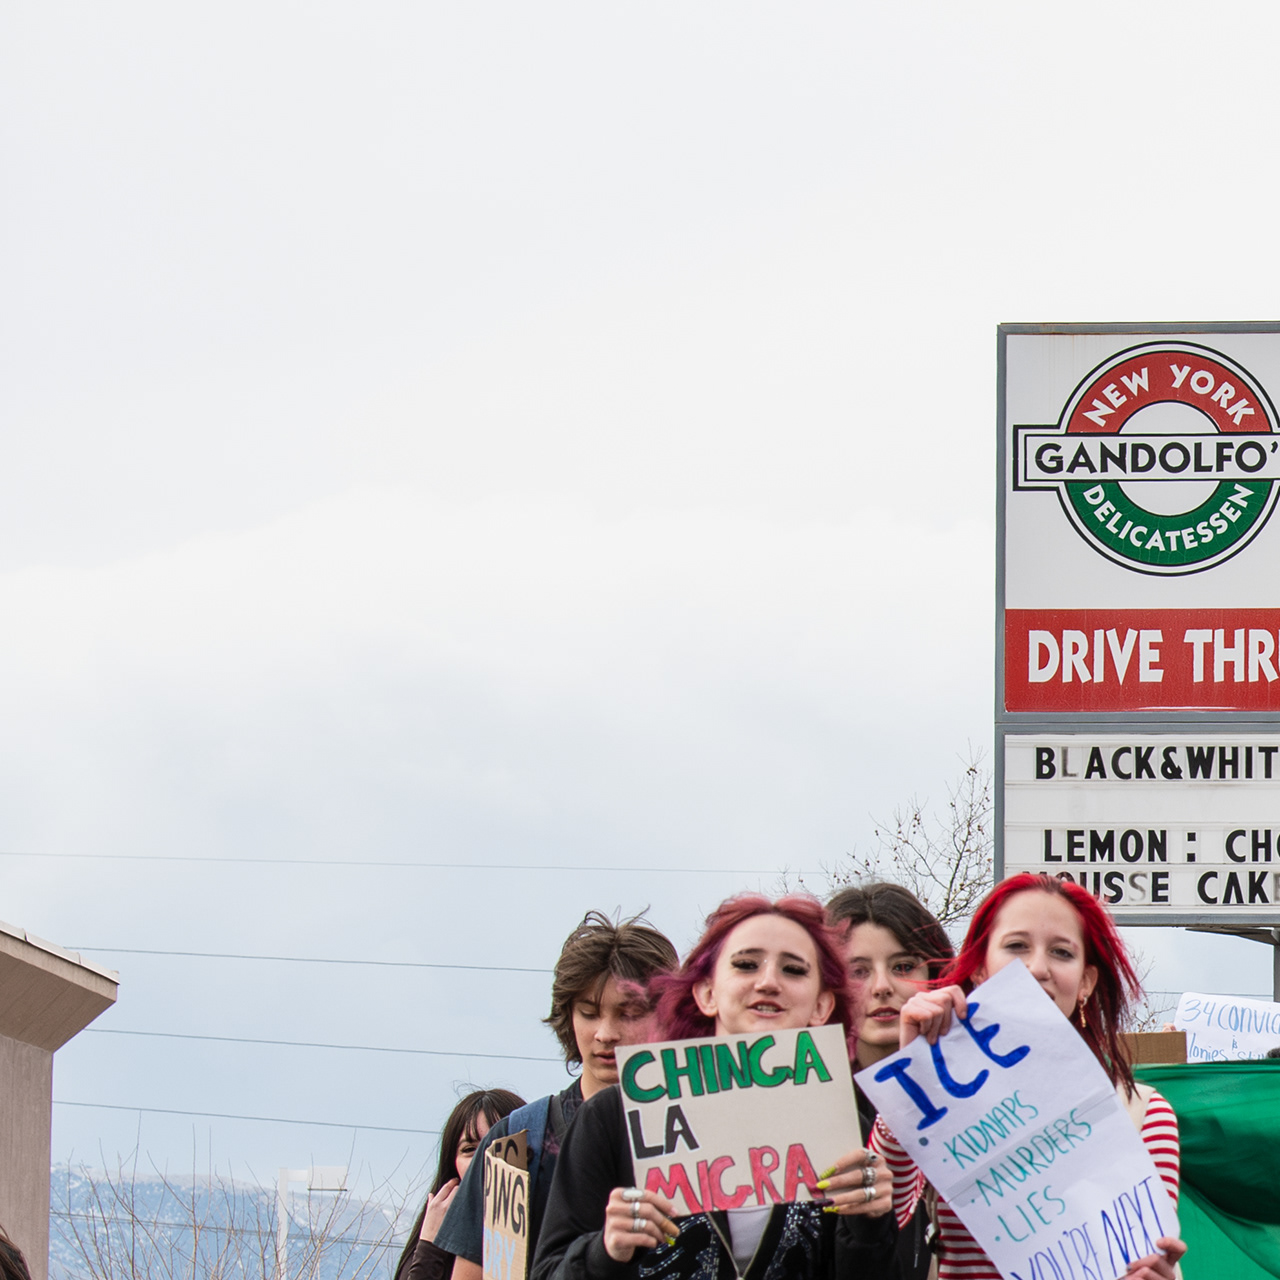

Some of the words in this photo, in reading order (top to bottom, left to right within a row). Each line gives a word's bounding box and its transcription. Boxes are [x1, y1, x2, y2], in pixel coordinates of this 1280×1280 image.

[1082, 367, 1149, 427] NEW
[1169, 364, 1255, 425] YORK
[1083, 484, 1255, 551] DELICATESSEN
[1028, 629, 1164, 684] DRIVE
[1044, 829, 1167, 862] LEMON
[1182, 999, 1214, 1026] 34
[621, 1030, 833, 1103] CHINGA
[874, 1002, 1031, 1131] ICE
[627, 1104, 700, 1159] LA
[944, 1090, 1038, 1168] KIDNAPS
[975, 1108, 1092, 1206] MURDERS
[645, 1144, 826, 1214] MIGRA
[997, 1185, 1067, 1242] LIES
[1101, 1176, 1165, 1278] NEXT
